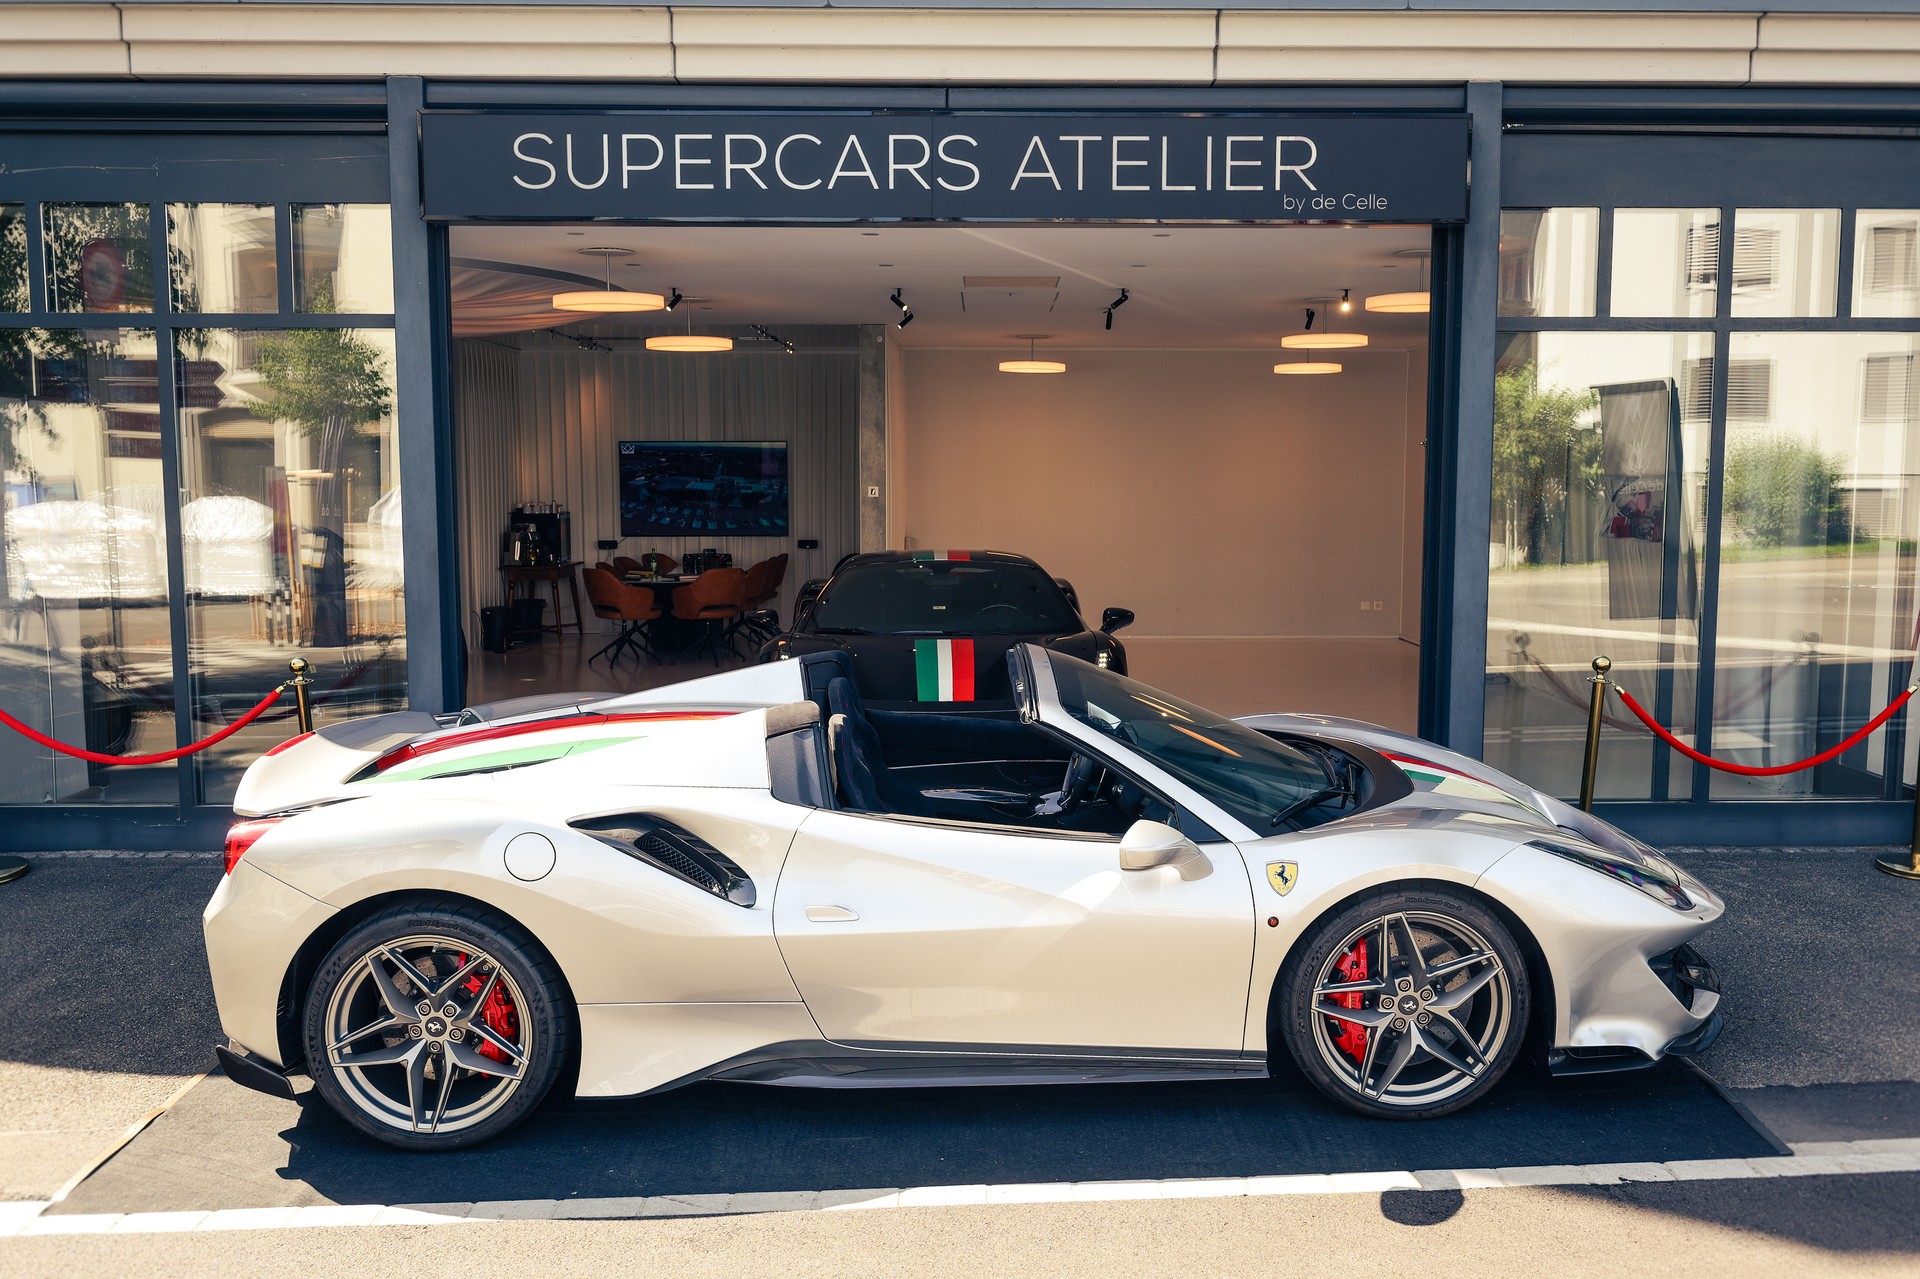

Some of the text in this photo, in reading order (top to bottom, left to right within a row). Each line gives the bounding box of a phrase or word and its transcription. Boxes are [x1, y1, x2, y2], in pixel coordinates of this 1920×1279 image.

[512, 132, 1318, 192] SUPERCARS ATELIER
[1283, 193, 1388, 214] by de Celle
[407, 919, 431, 928] Pilot
[431, 919, 460, 931] Sport
[308, 980, 328, 1036] MICHELIN
[1298, 964, 1313, 1009] MICHELIN
